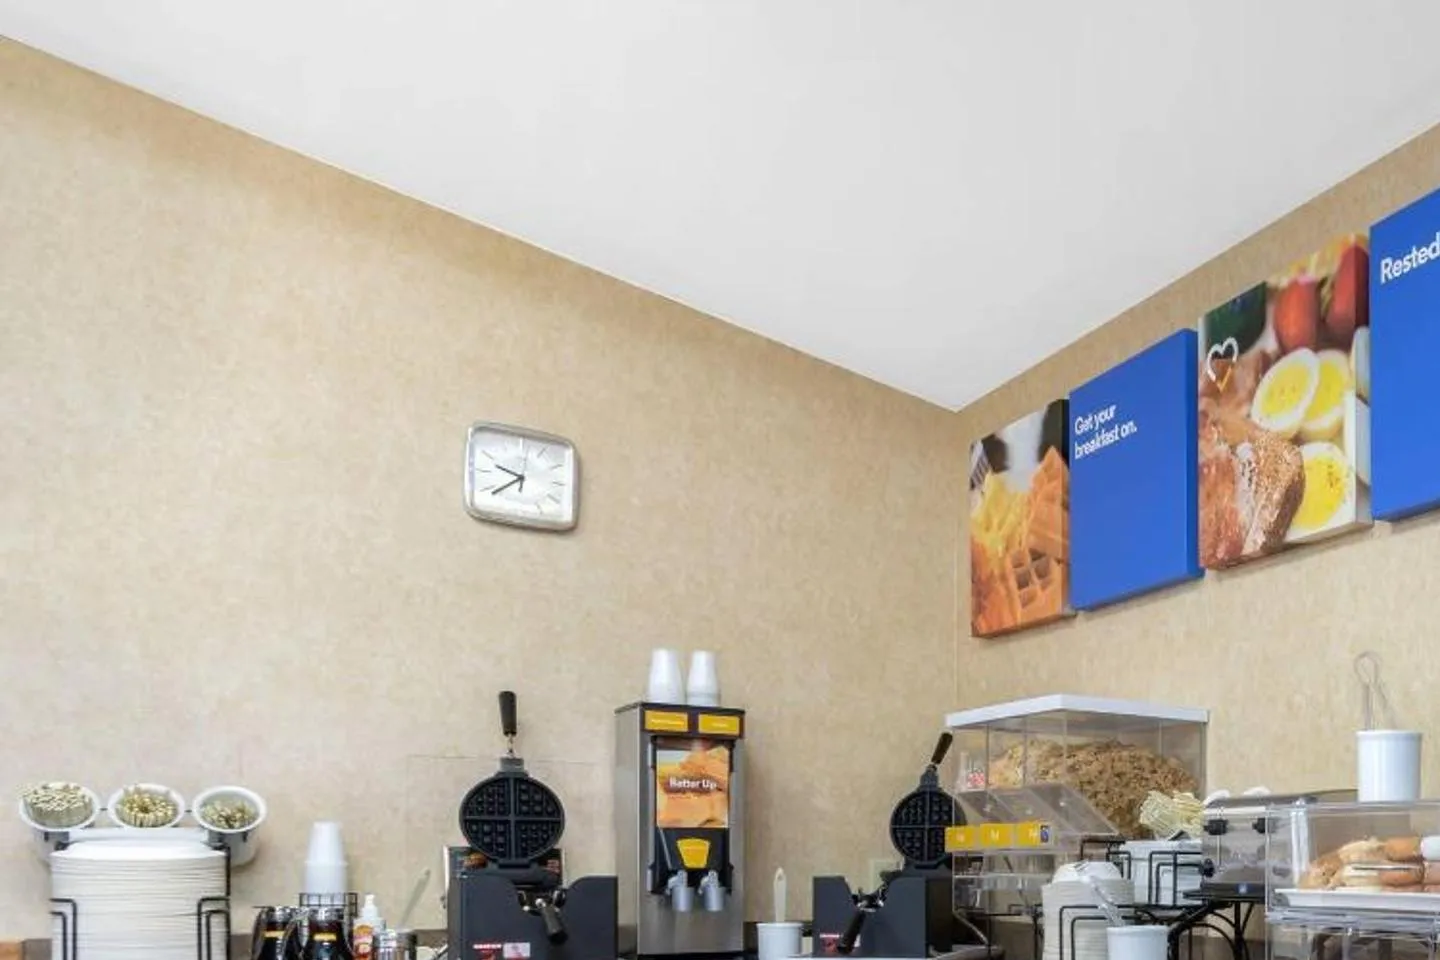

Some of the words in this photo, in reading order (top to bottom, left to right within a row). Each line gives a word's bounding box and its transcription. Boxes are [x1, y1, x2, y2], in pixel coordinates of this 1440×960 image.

[1074, 414, 1093, 436] Get
[1094, 404, 1117, 431] your
[1074, 424, 1120, 460] breakfast
[1120, 420, 1138, 439] on.
[702, 778, 717, 790] Up
